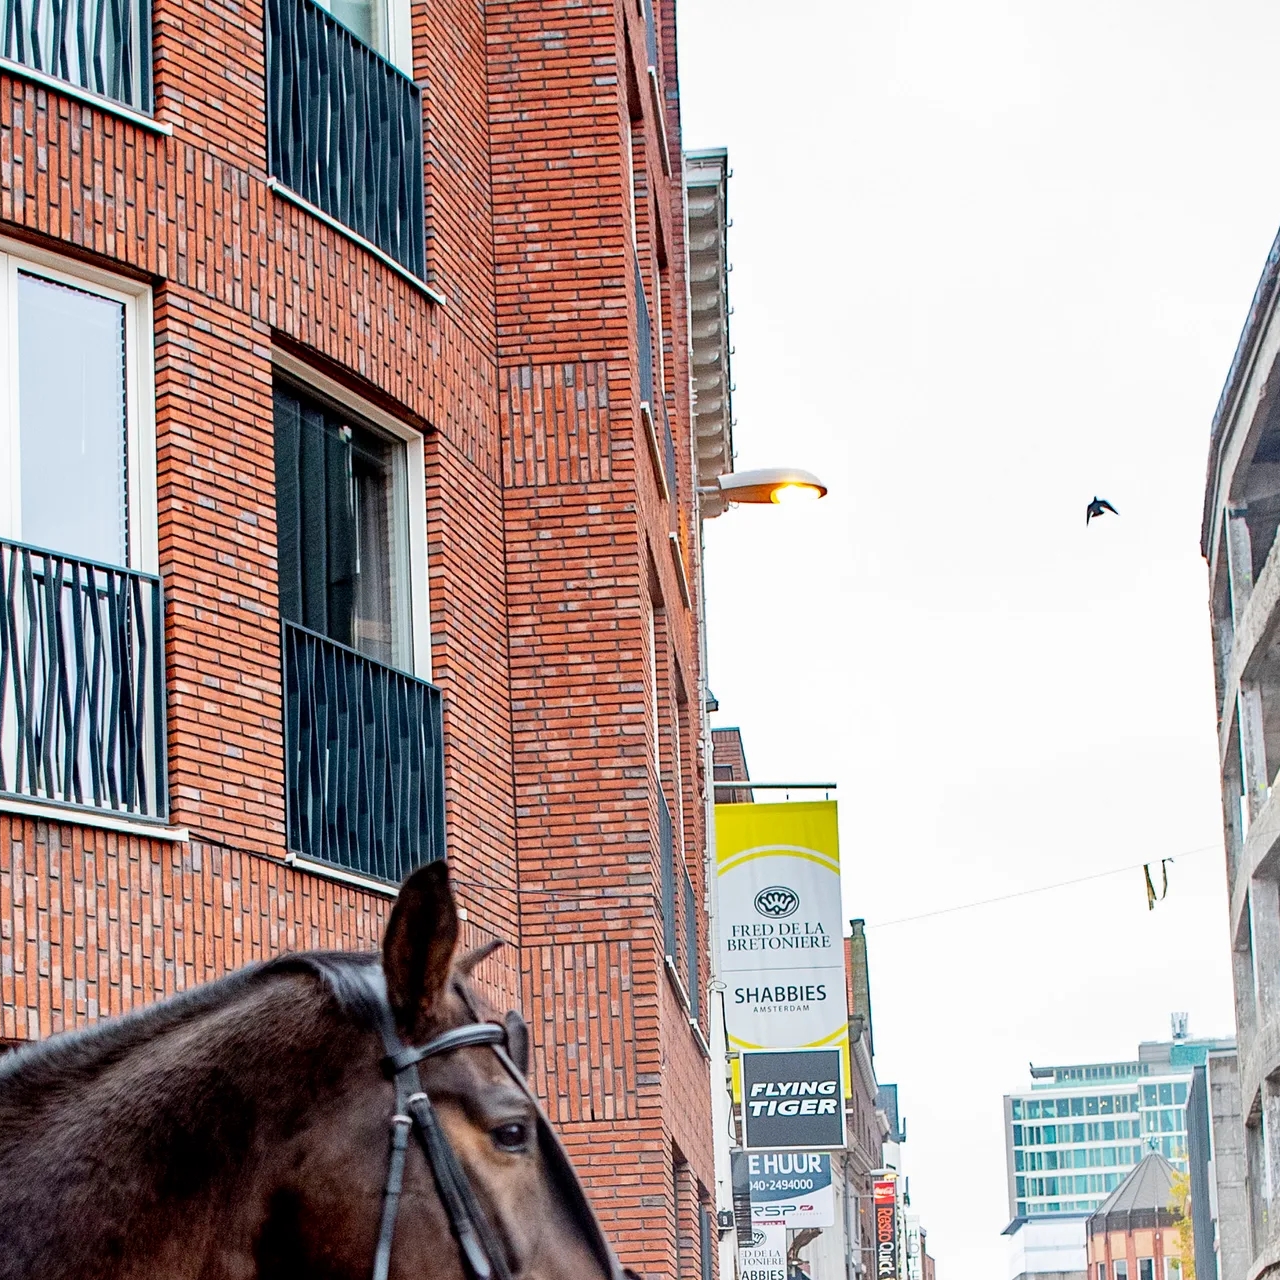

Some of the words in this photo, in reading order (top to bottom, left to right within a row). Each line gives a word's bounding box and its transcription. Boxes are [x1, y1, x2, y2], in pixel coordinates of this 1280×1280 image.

[732, 923, 774, 937] FRED
[779, 922, 800, 936] DE
[805, 922, 825, 935] LA
[727, 935, 832, 951] BRETONIERE
[735, 984, 827, 1004] SHABBIES
[753, 1004, 810, 1013] AMSTERDAM
[750, 1080, 837, 1097] FLYING
[748, 1098, 838, 1117] TIGER
[748, 1154, 761, 1175] E
[764, 1153, 822, 1175] HUUR
[742, 1257, 785, 1266] TONIERE
[909, 1229, 920, 1280] HOTE
[741, 1269, 785, 1280] ABBIES
